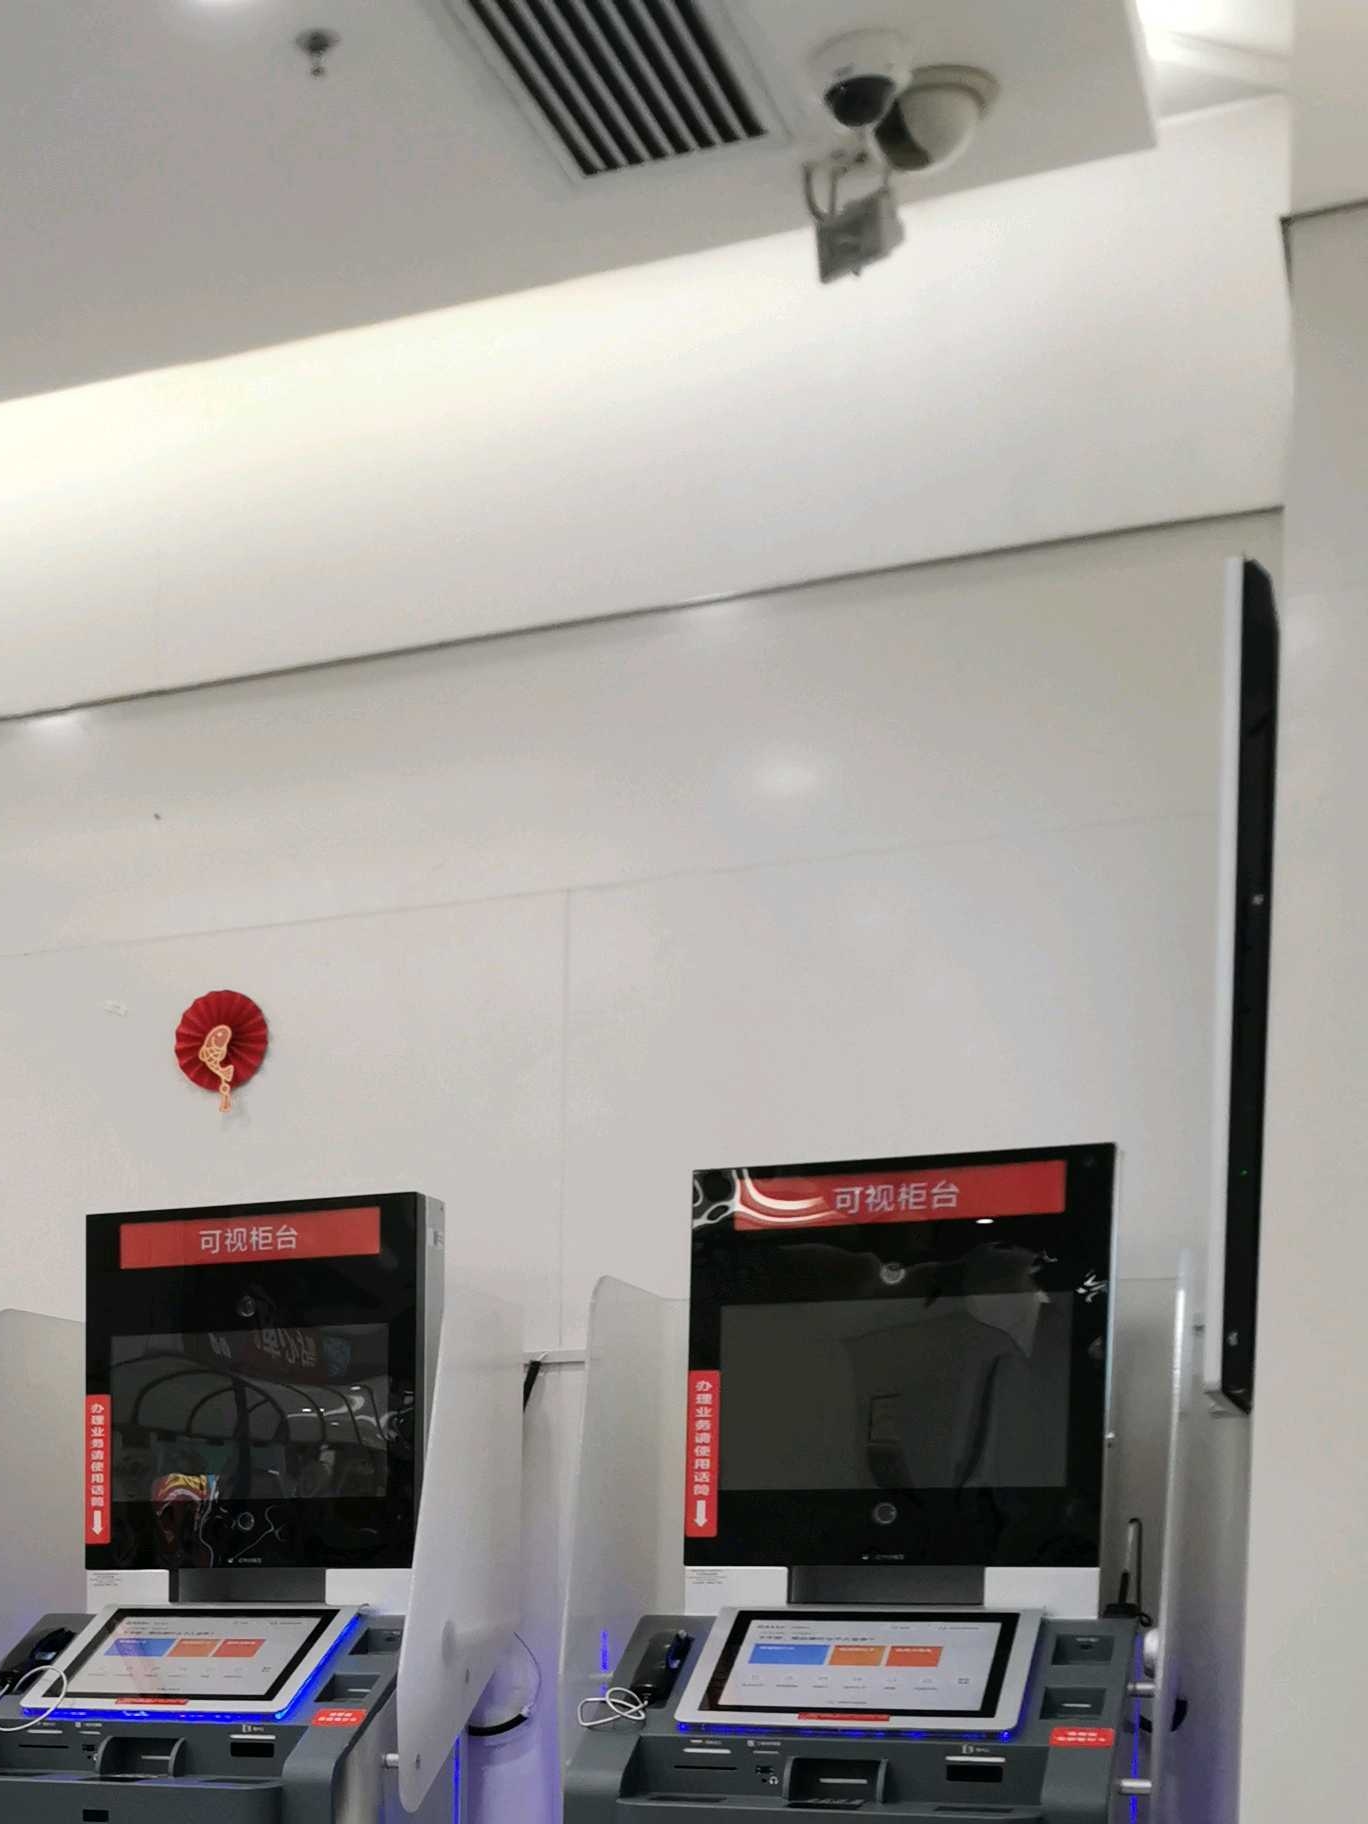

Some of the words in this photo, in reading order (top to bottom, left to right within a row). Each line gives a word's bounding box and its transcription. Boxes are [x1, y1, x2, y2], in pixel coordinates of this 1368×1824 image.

[832, 1180, 960, 1214] 可视柜台
[199, 1224, 299, 1254] 可视柜台
